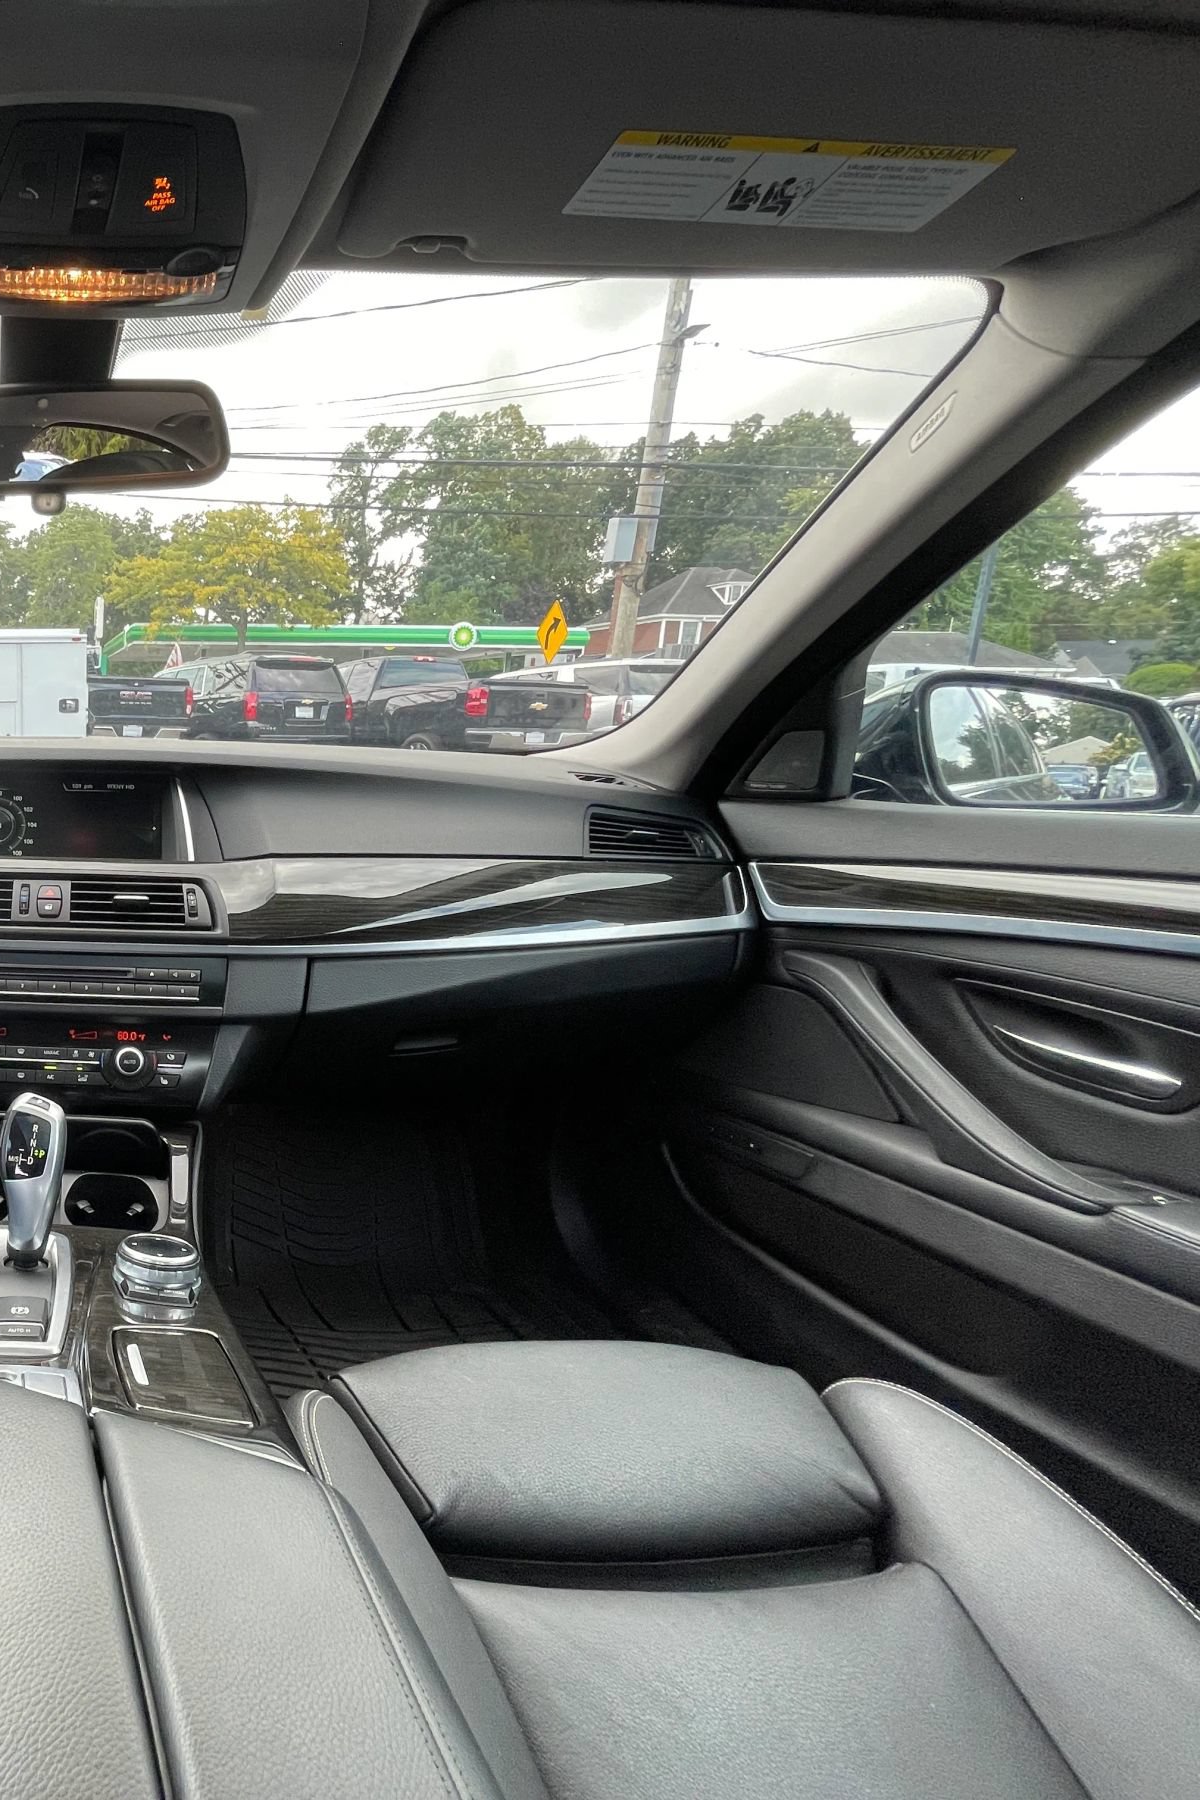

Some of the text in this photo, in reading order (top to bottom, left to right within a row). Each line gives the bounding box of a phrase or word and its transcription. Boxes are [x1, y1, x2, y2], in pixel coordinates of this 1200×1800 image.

[656, 134, 732, 148] WARNING
[861, 145, 991, 161] AVERTISSEMENT
[117, 1031, 137, 1040] 60.0
[32, 1124, 39, 1133] R
[30, 1138, 37, 1147] N
[38, 1149, 46, 1158] P
[7, 1155, 19, 1163] M/S
[27, 1156, 34, 1165] D
